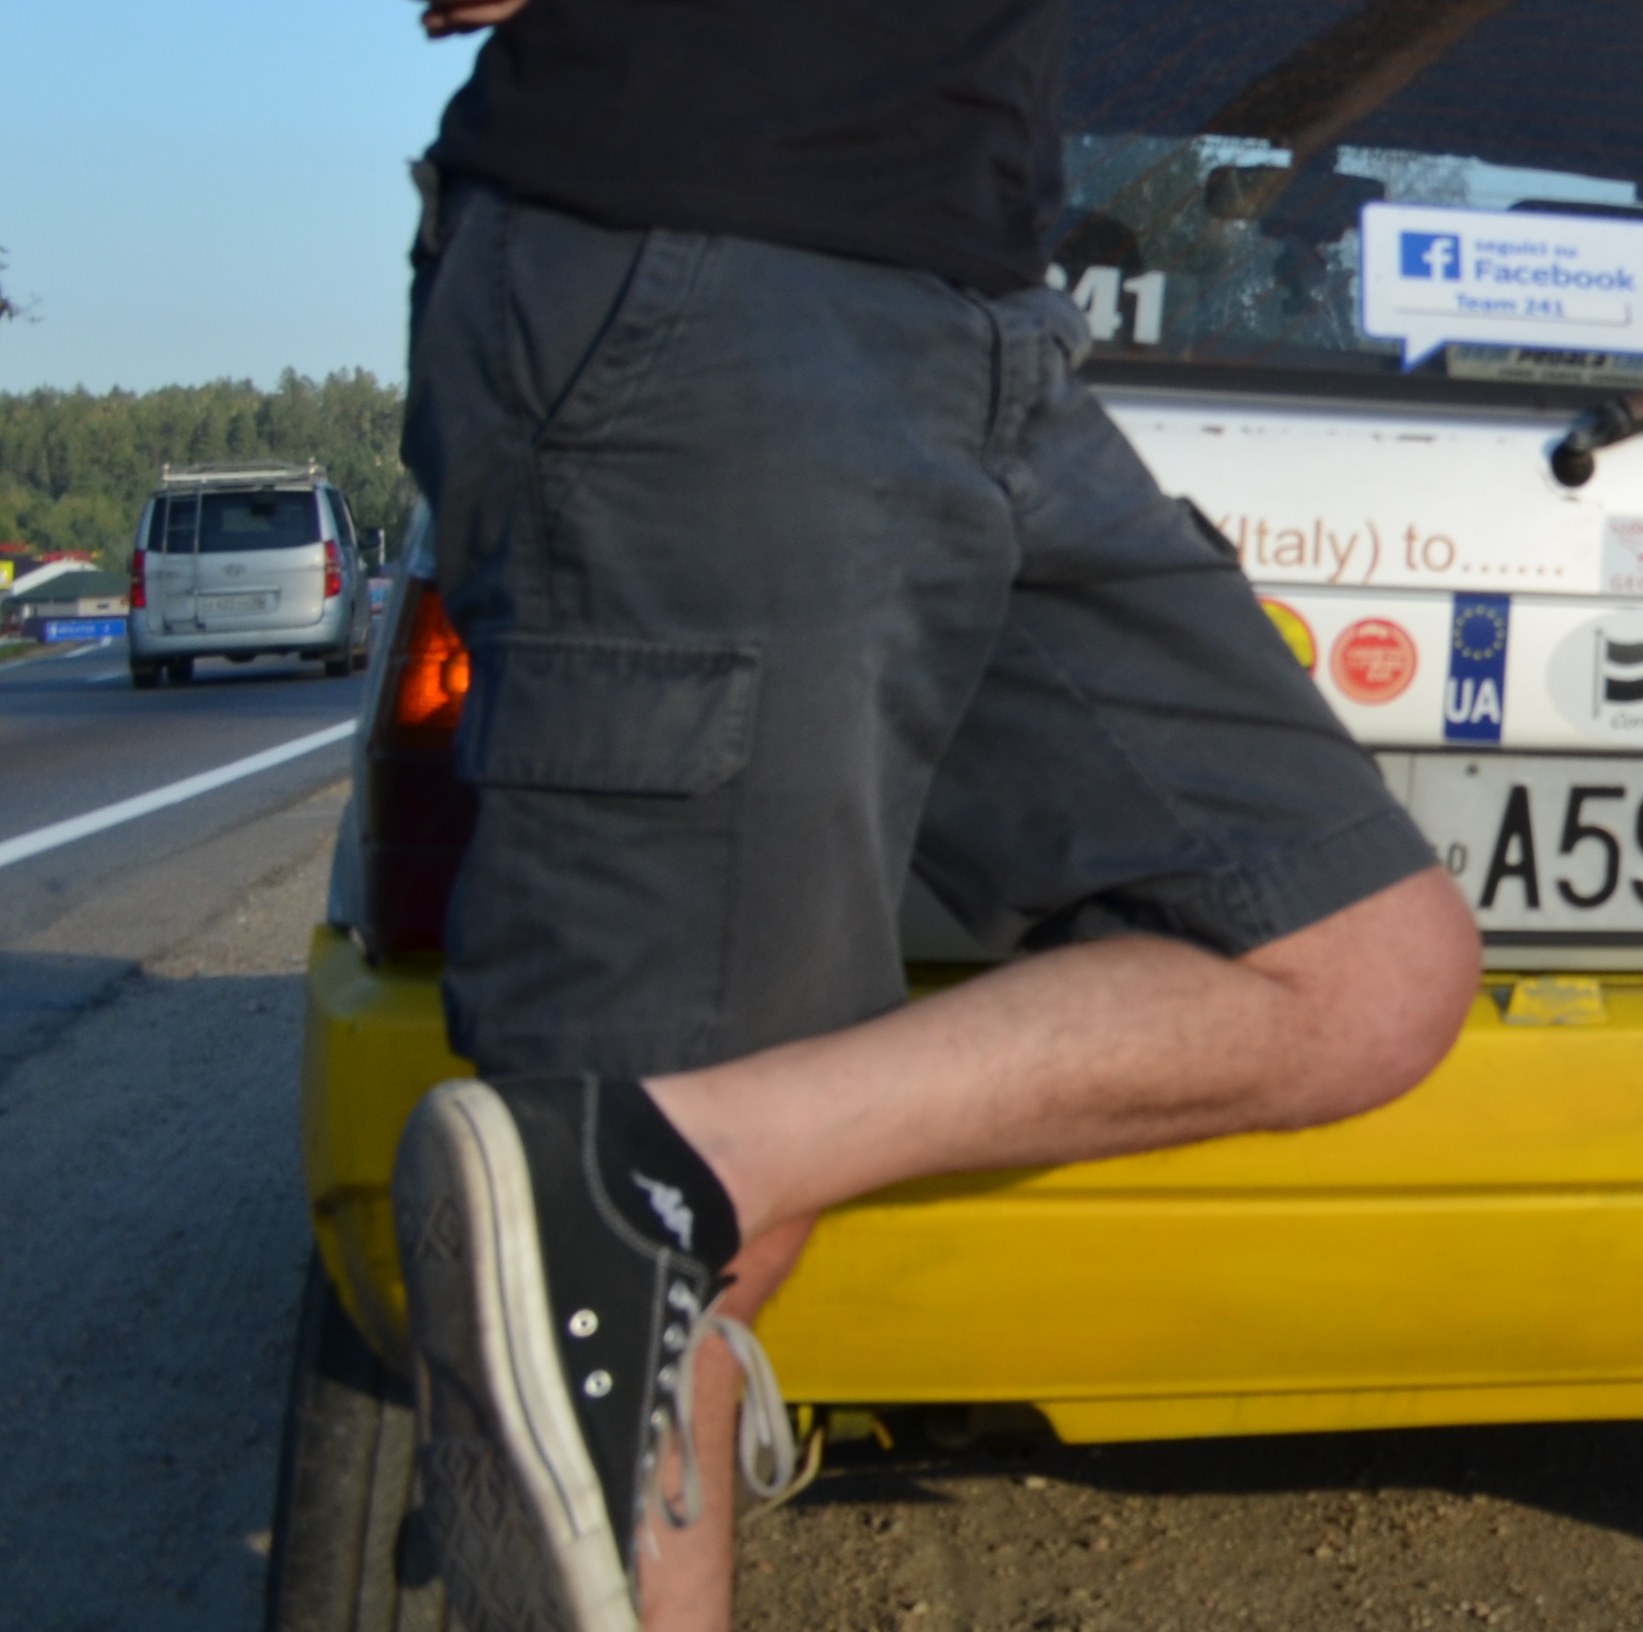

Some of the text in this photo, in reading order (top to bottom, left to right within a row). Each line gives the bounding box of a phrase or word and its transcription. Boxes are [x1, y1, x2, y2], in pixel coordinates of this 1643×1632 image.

[1474, 259, 1634, 293] Facebook
[1044, 263, 1165, 345] 41
[1455, 294, 1565, 316] Team 241
[1445, 677, 1501, 723] UA
